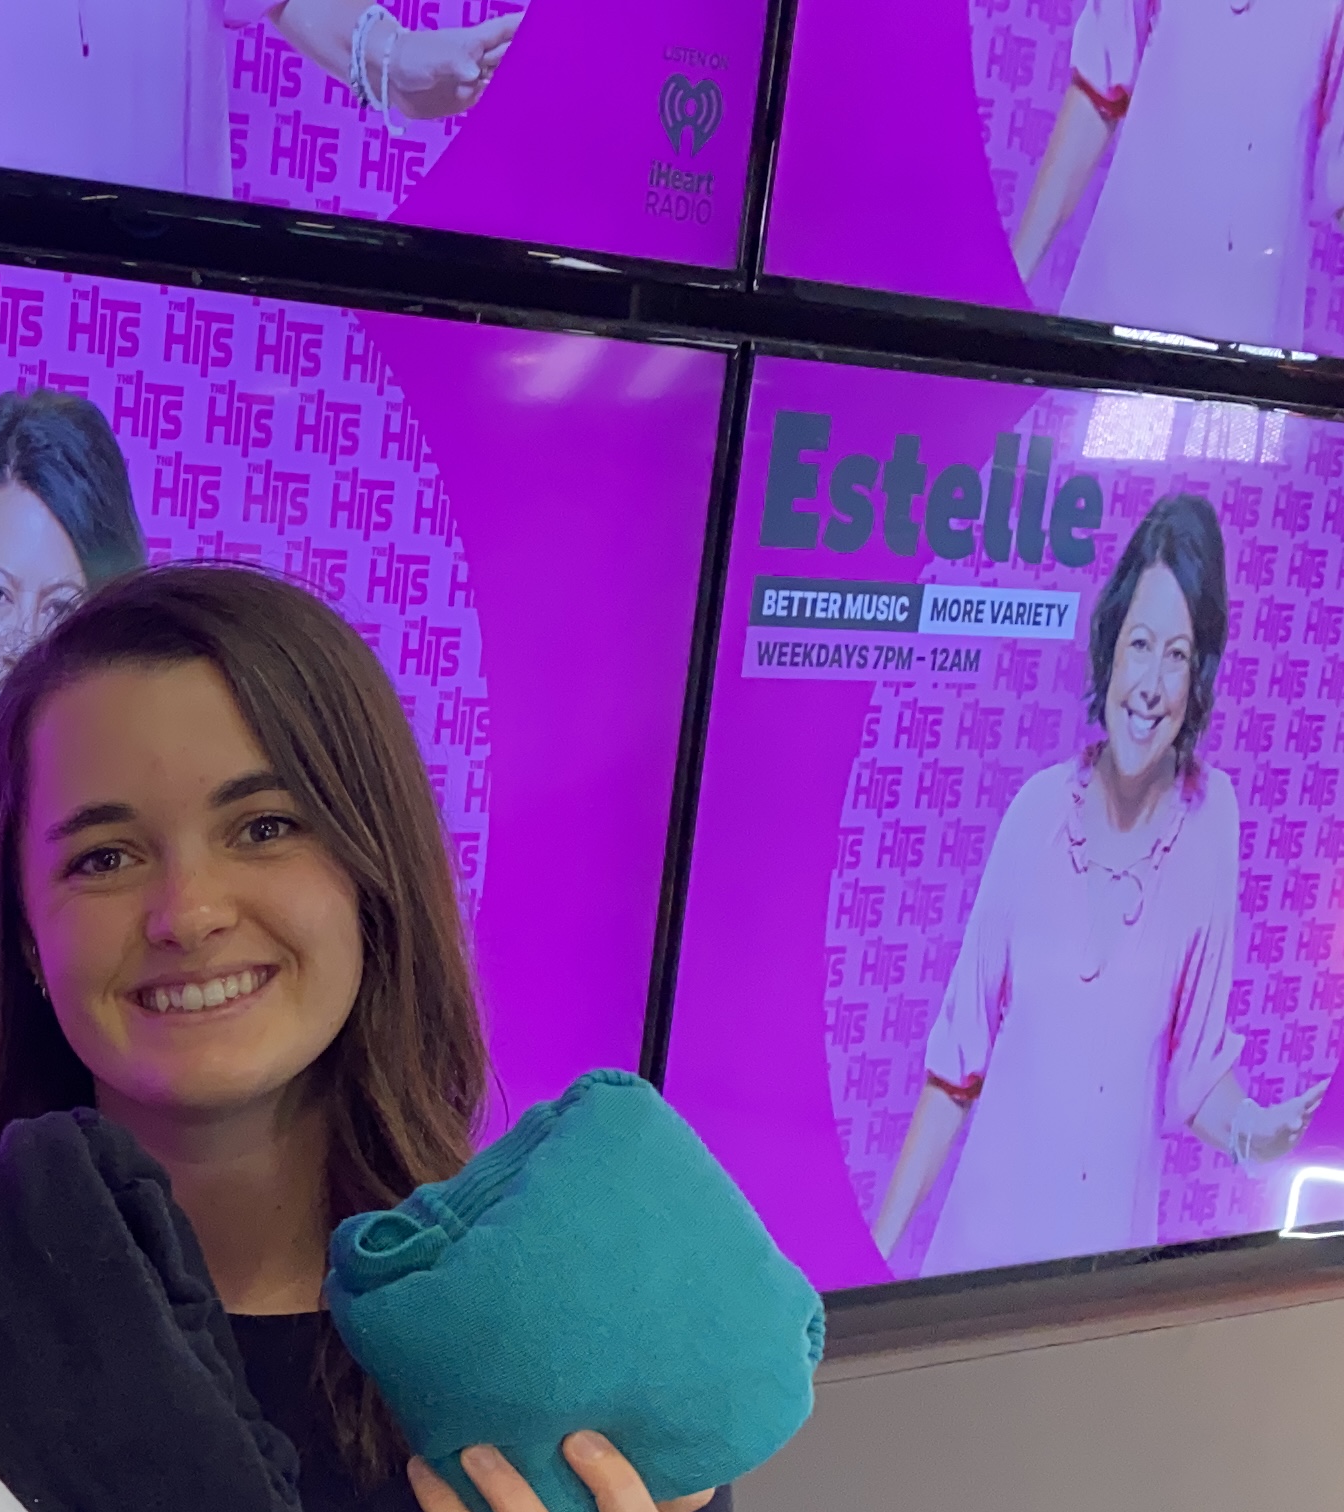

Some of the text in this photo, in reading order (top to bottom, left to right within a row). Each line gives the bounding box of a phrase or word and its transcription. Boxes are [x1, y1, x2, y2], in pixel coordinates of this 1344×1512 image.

[663, 46, 707, 66] LISTEN
[649, 160, 714, 196] iHeart
[645, 191, 711, 225] RADIO
[73, 289, 90, 300] THE
[20, 364, 37, 375] THE
[117, 374, 134, 384] THE
[760, 410, 1104, 567] Estelle
[762, 589, 1069, 627] BETTER MUSIC MORE VARIETY
[757, 641, 868, 669] WEEKDAYS
[872, 645, 914, 670] 7PM
[930, 648, 981, 672] 12AM
